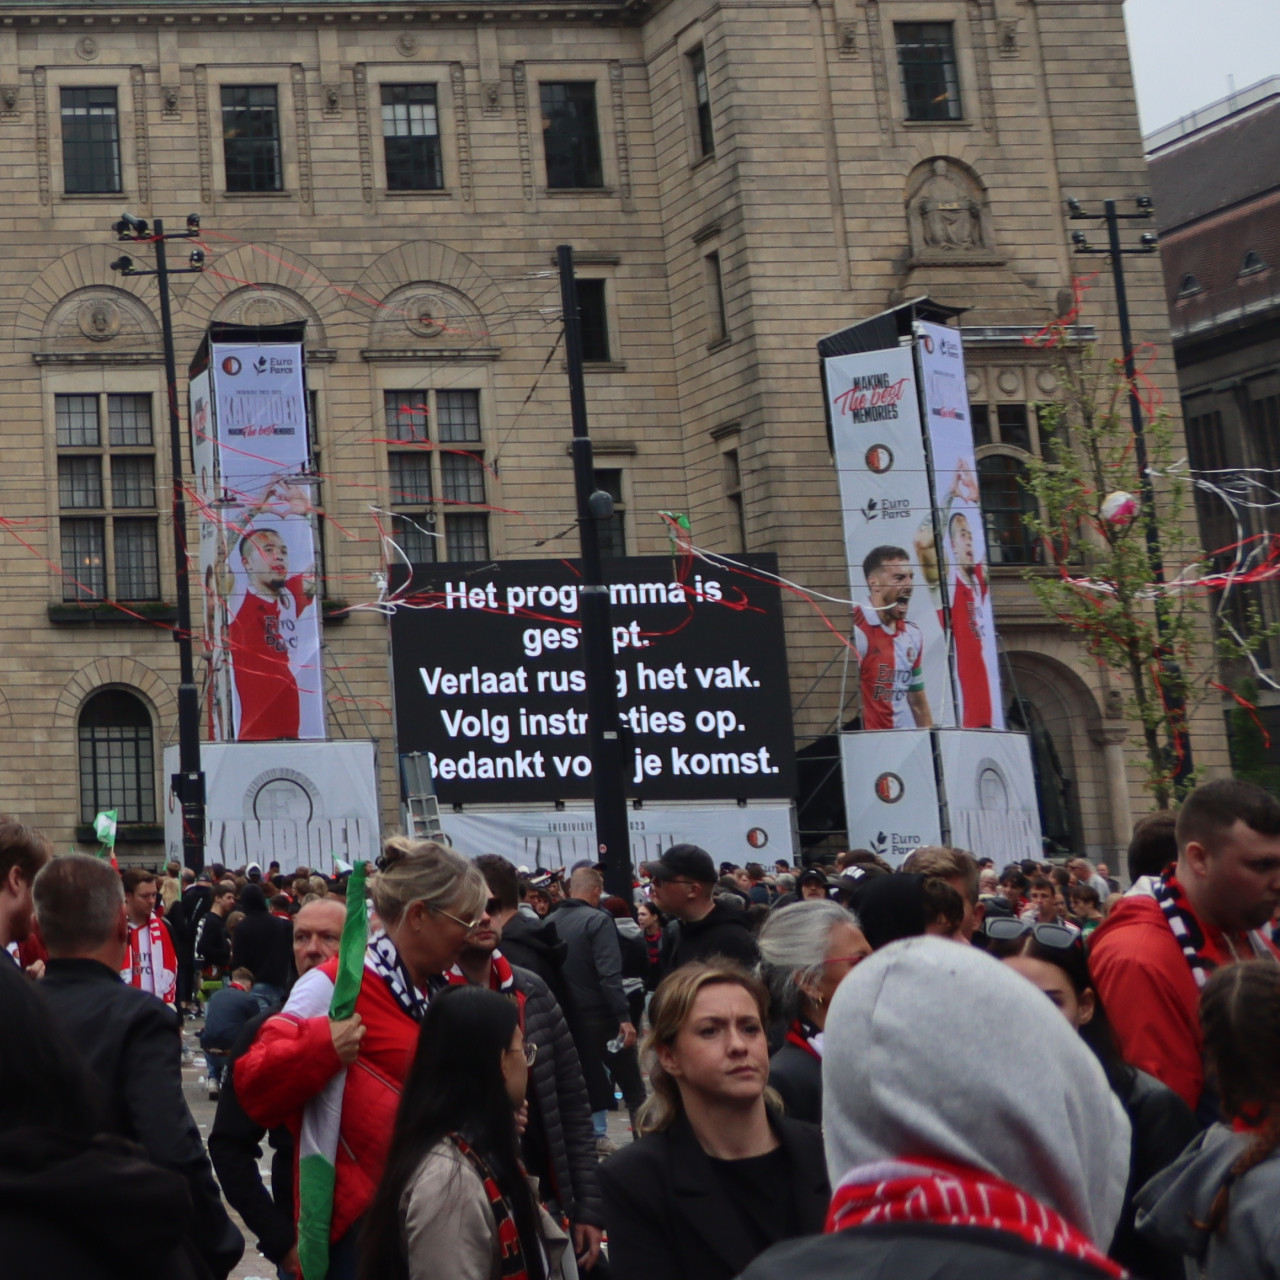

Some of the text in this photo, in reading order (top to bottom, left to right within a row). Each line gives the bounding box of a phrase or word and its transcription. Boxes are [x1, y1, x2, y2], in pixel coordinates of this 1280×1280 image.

[269, 358, 293, 367] Euro
[853, 373, 889, 391] MAKING
[834, 386, 867, 415] The
[870, 378, 911, 405] best
[852, 404, 899, 424] MEMORIES
[881, 499, 910, 509] Euro
[881, 509, 911, 520] Parcs
[444, 575, 723, 614] Het progmma is
[523, 620, 650, 657] gespt.
[419, 660, 761, 698] Verlaat rusg het vak.
[441, 705, 746, 744] Volg instrties op.
[633, 748, 662, 783] je
[671, 746, 780, 777] komst.
[548, 821, 594, 833] EREDIVISIE
[891, 833, 921, 844] Euro
